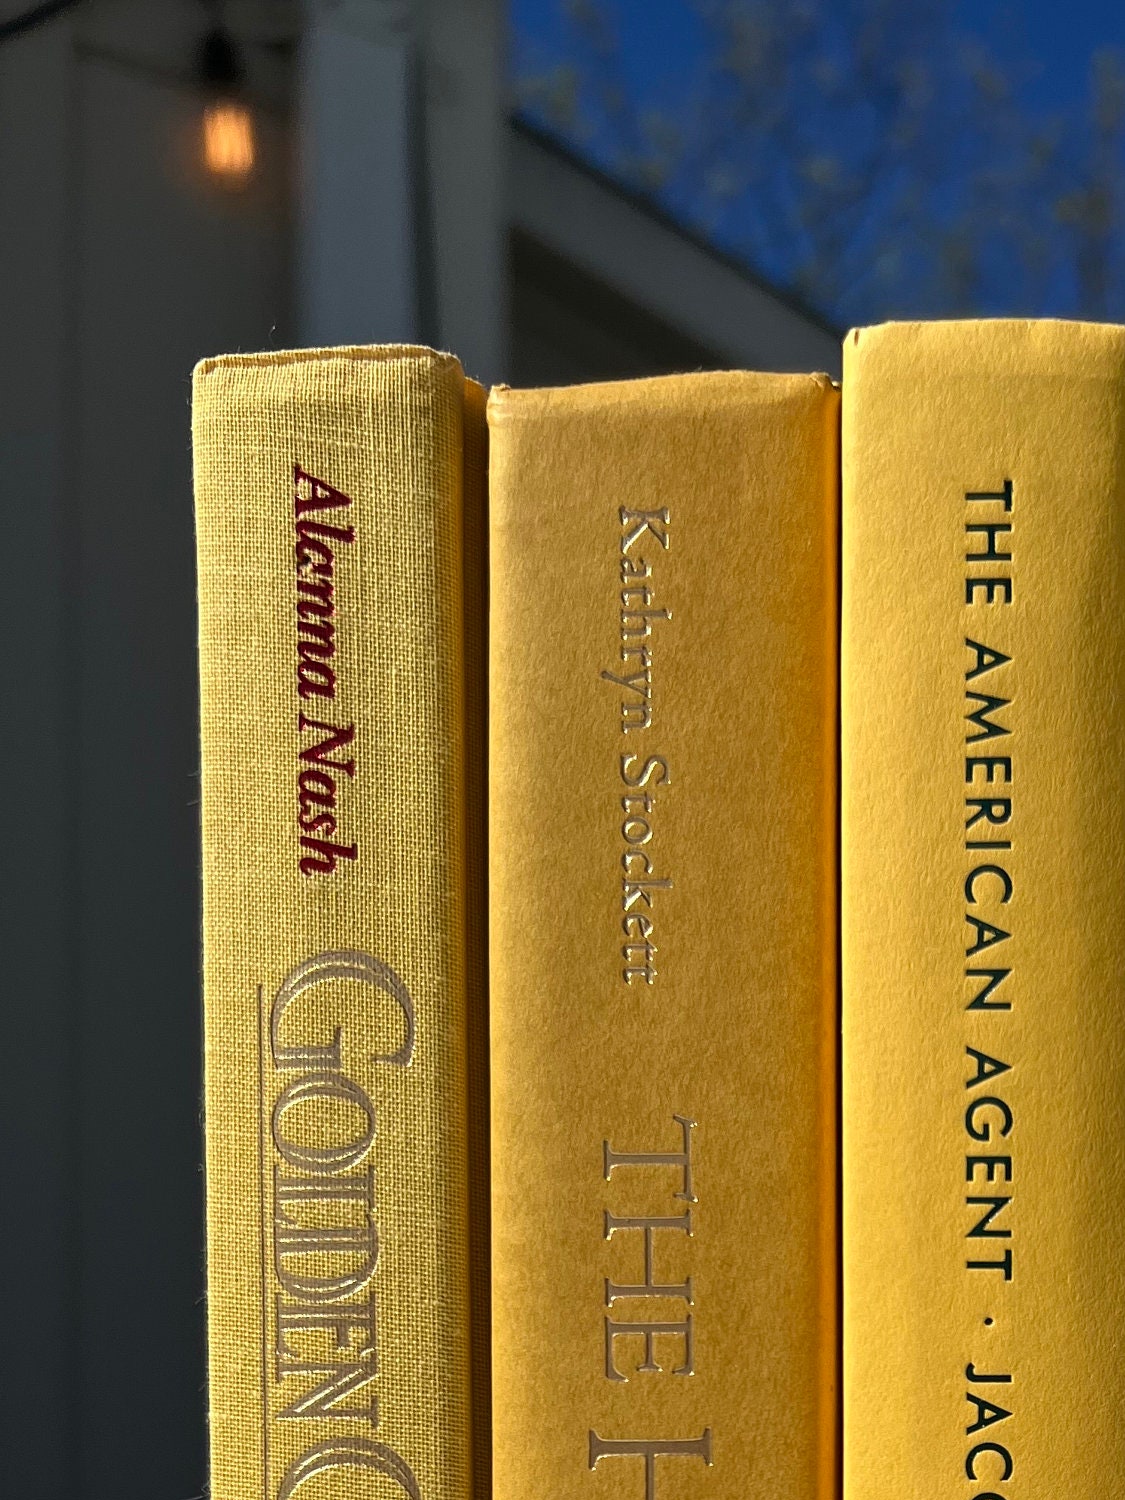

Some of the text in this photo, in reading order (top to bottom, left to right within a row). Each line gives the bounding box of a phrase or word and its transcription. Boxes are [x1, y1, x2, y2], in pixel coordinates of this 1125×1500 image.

[292, 464, 358, 877] Alanna Nash
[964, 480, 1013, 605] THE
[600, 505, 674, 986] Kathryn Stockett
[964, 637, 1013, 1012] AMERICAN
[269, 948, 416, 1426] GOLDEN
[602, 1114, 699, 1383] THE
[964, 1046, 1014, 1282] AGENT
